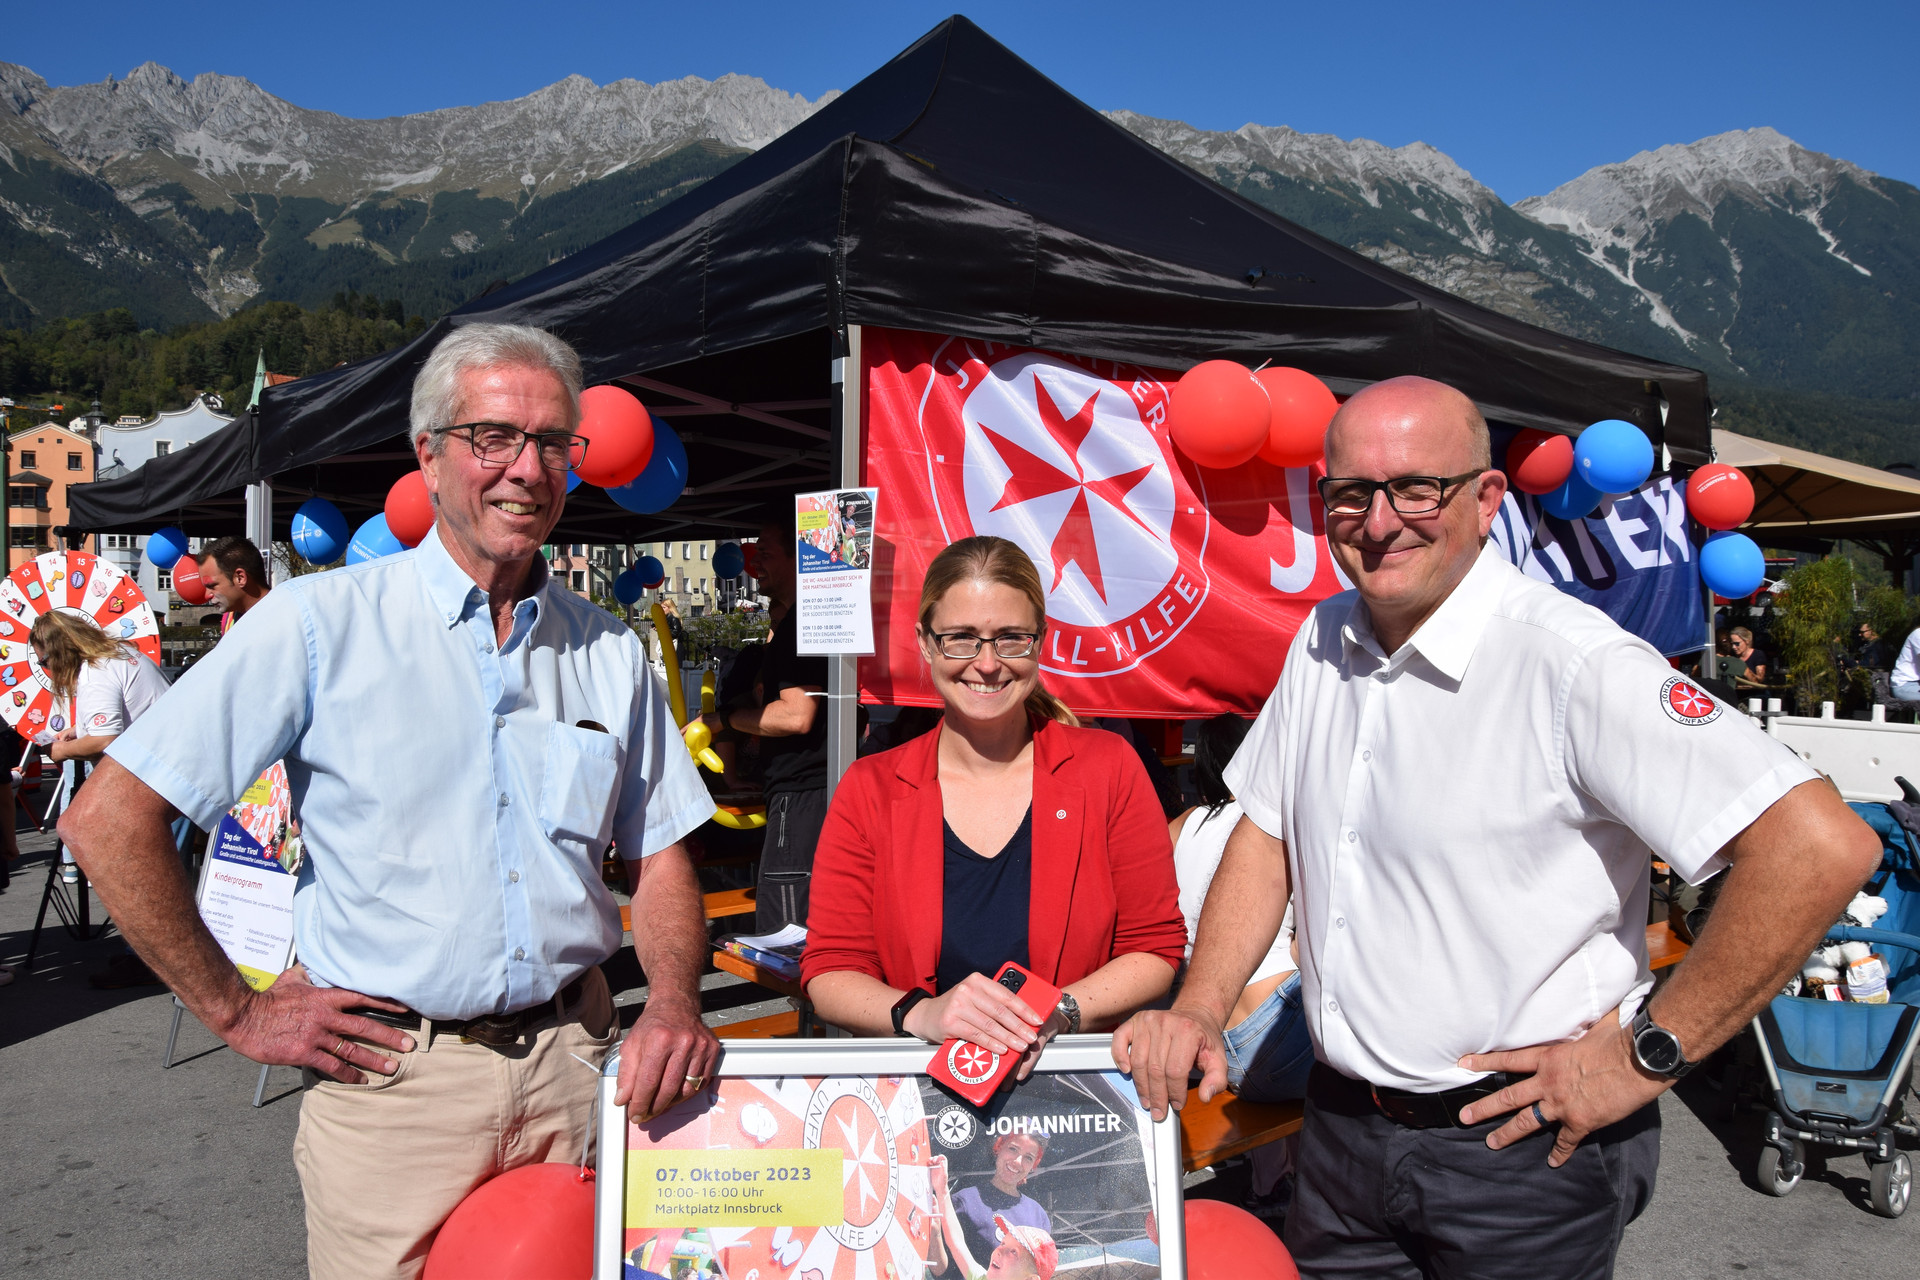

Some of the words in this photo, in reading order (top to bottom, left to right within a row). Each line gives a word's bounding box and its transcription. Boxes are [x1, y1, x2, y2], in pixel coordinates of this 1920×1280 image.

[22, 569, 30, 577] 13
[105, 568, 113, 577] 16
[1, 588, 9, 598] 12
[126, 588, 136, 597] 17
[142, 616, 149, 626] 18
[224, 832, 232, 842] Tag
[221, 842, 246, 853] Johanniter
[247, 847, 258, 856] Tirol
[214, 872, 263, 890] Kinderprogramm
[986, 1114, 1121, 1136] JOHANNITER
[656, 1168, 684, 1181] 07.
[690, 1168, 760, 1181] Oktober
[766, 1167, 811, 1181] 2023
[742, 1187, 764, 1197] Uhr
[656, 1204, 719, 1216] Marktplatz
[724, 1203, 783, 1214] Innsbruck
